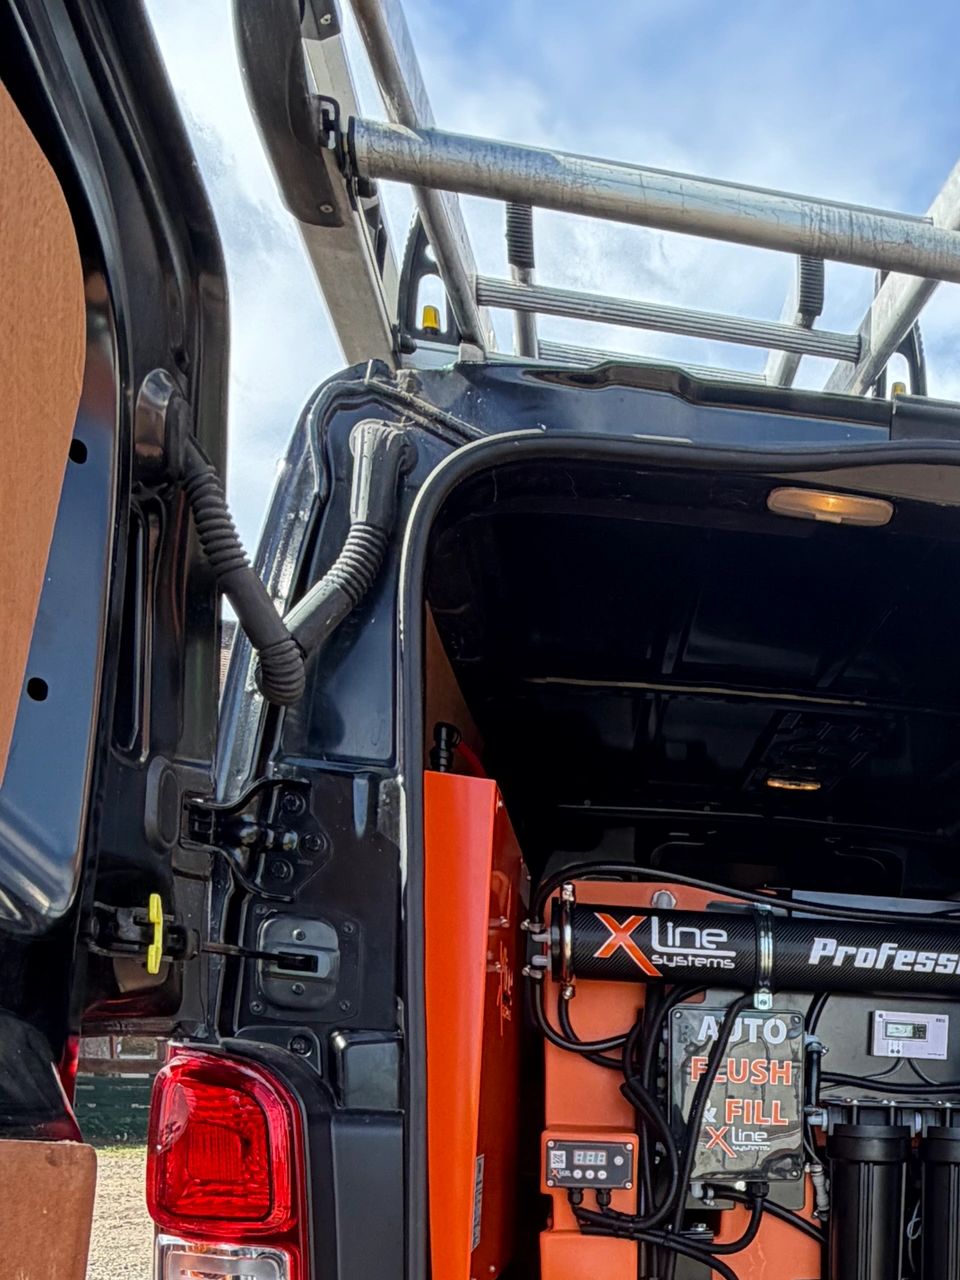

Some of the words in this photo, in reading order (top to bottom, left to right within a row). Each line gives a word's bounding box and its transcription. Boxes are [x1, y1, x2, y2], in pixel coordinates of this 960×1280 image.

[651, 954, 736, 969] systems
[697, 1016, 788, 1045] AUTO
[725, 1098, 789, 1126] FILL
